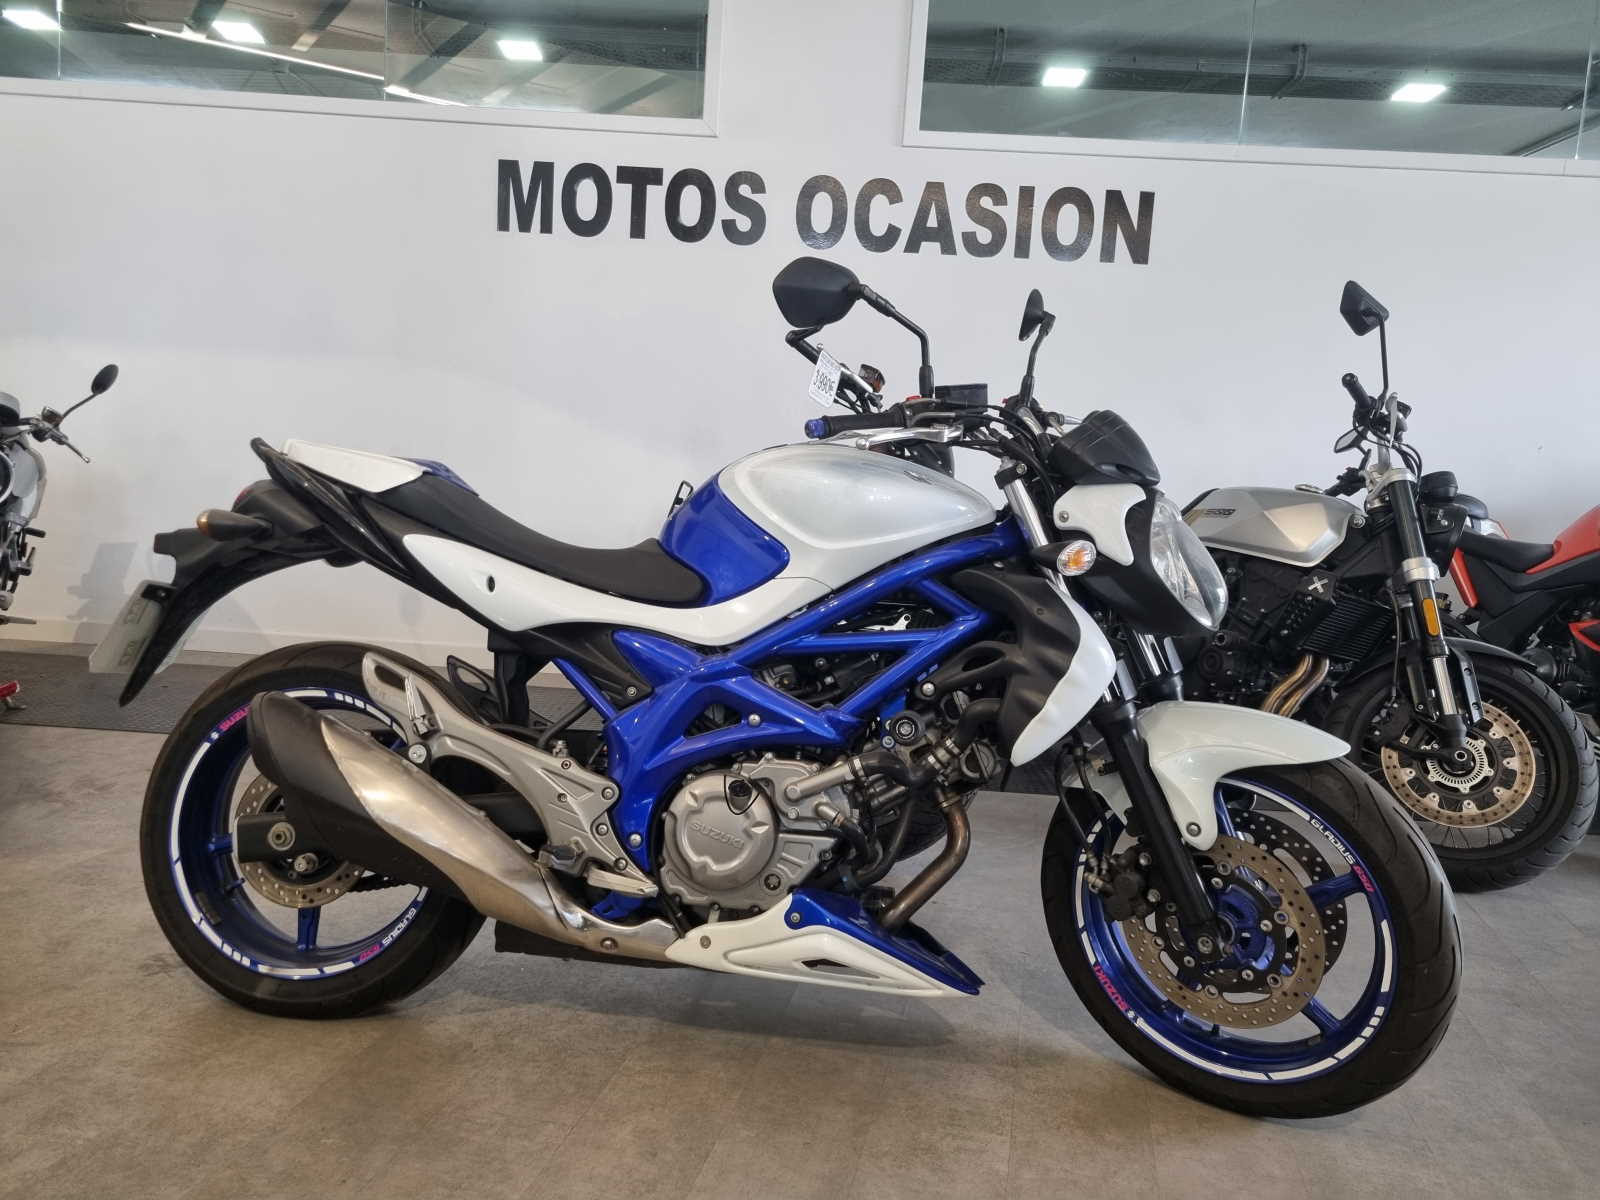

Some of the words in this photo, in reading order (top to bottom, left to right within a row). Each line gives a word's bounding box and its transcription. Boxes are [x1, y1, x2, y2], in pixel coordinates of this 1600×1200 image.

[496, 158, 767, 246] MOTOS
[795, 174, 1156, 266] OCASION
[690, 821, 746, 849] SUZUKI
[1309, 817, 1357, 865] GLADIUS
[381, 906, 418, 946] GLADIUS
[1092, 962, 1130, 1011] SUZUKI
